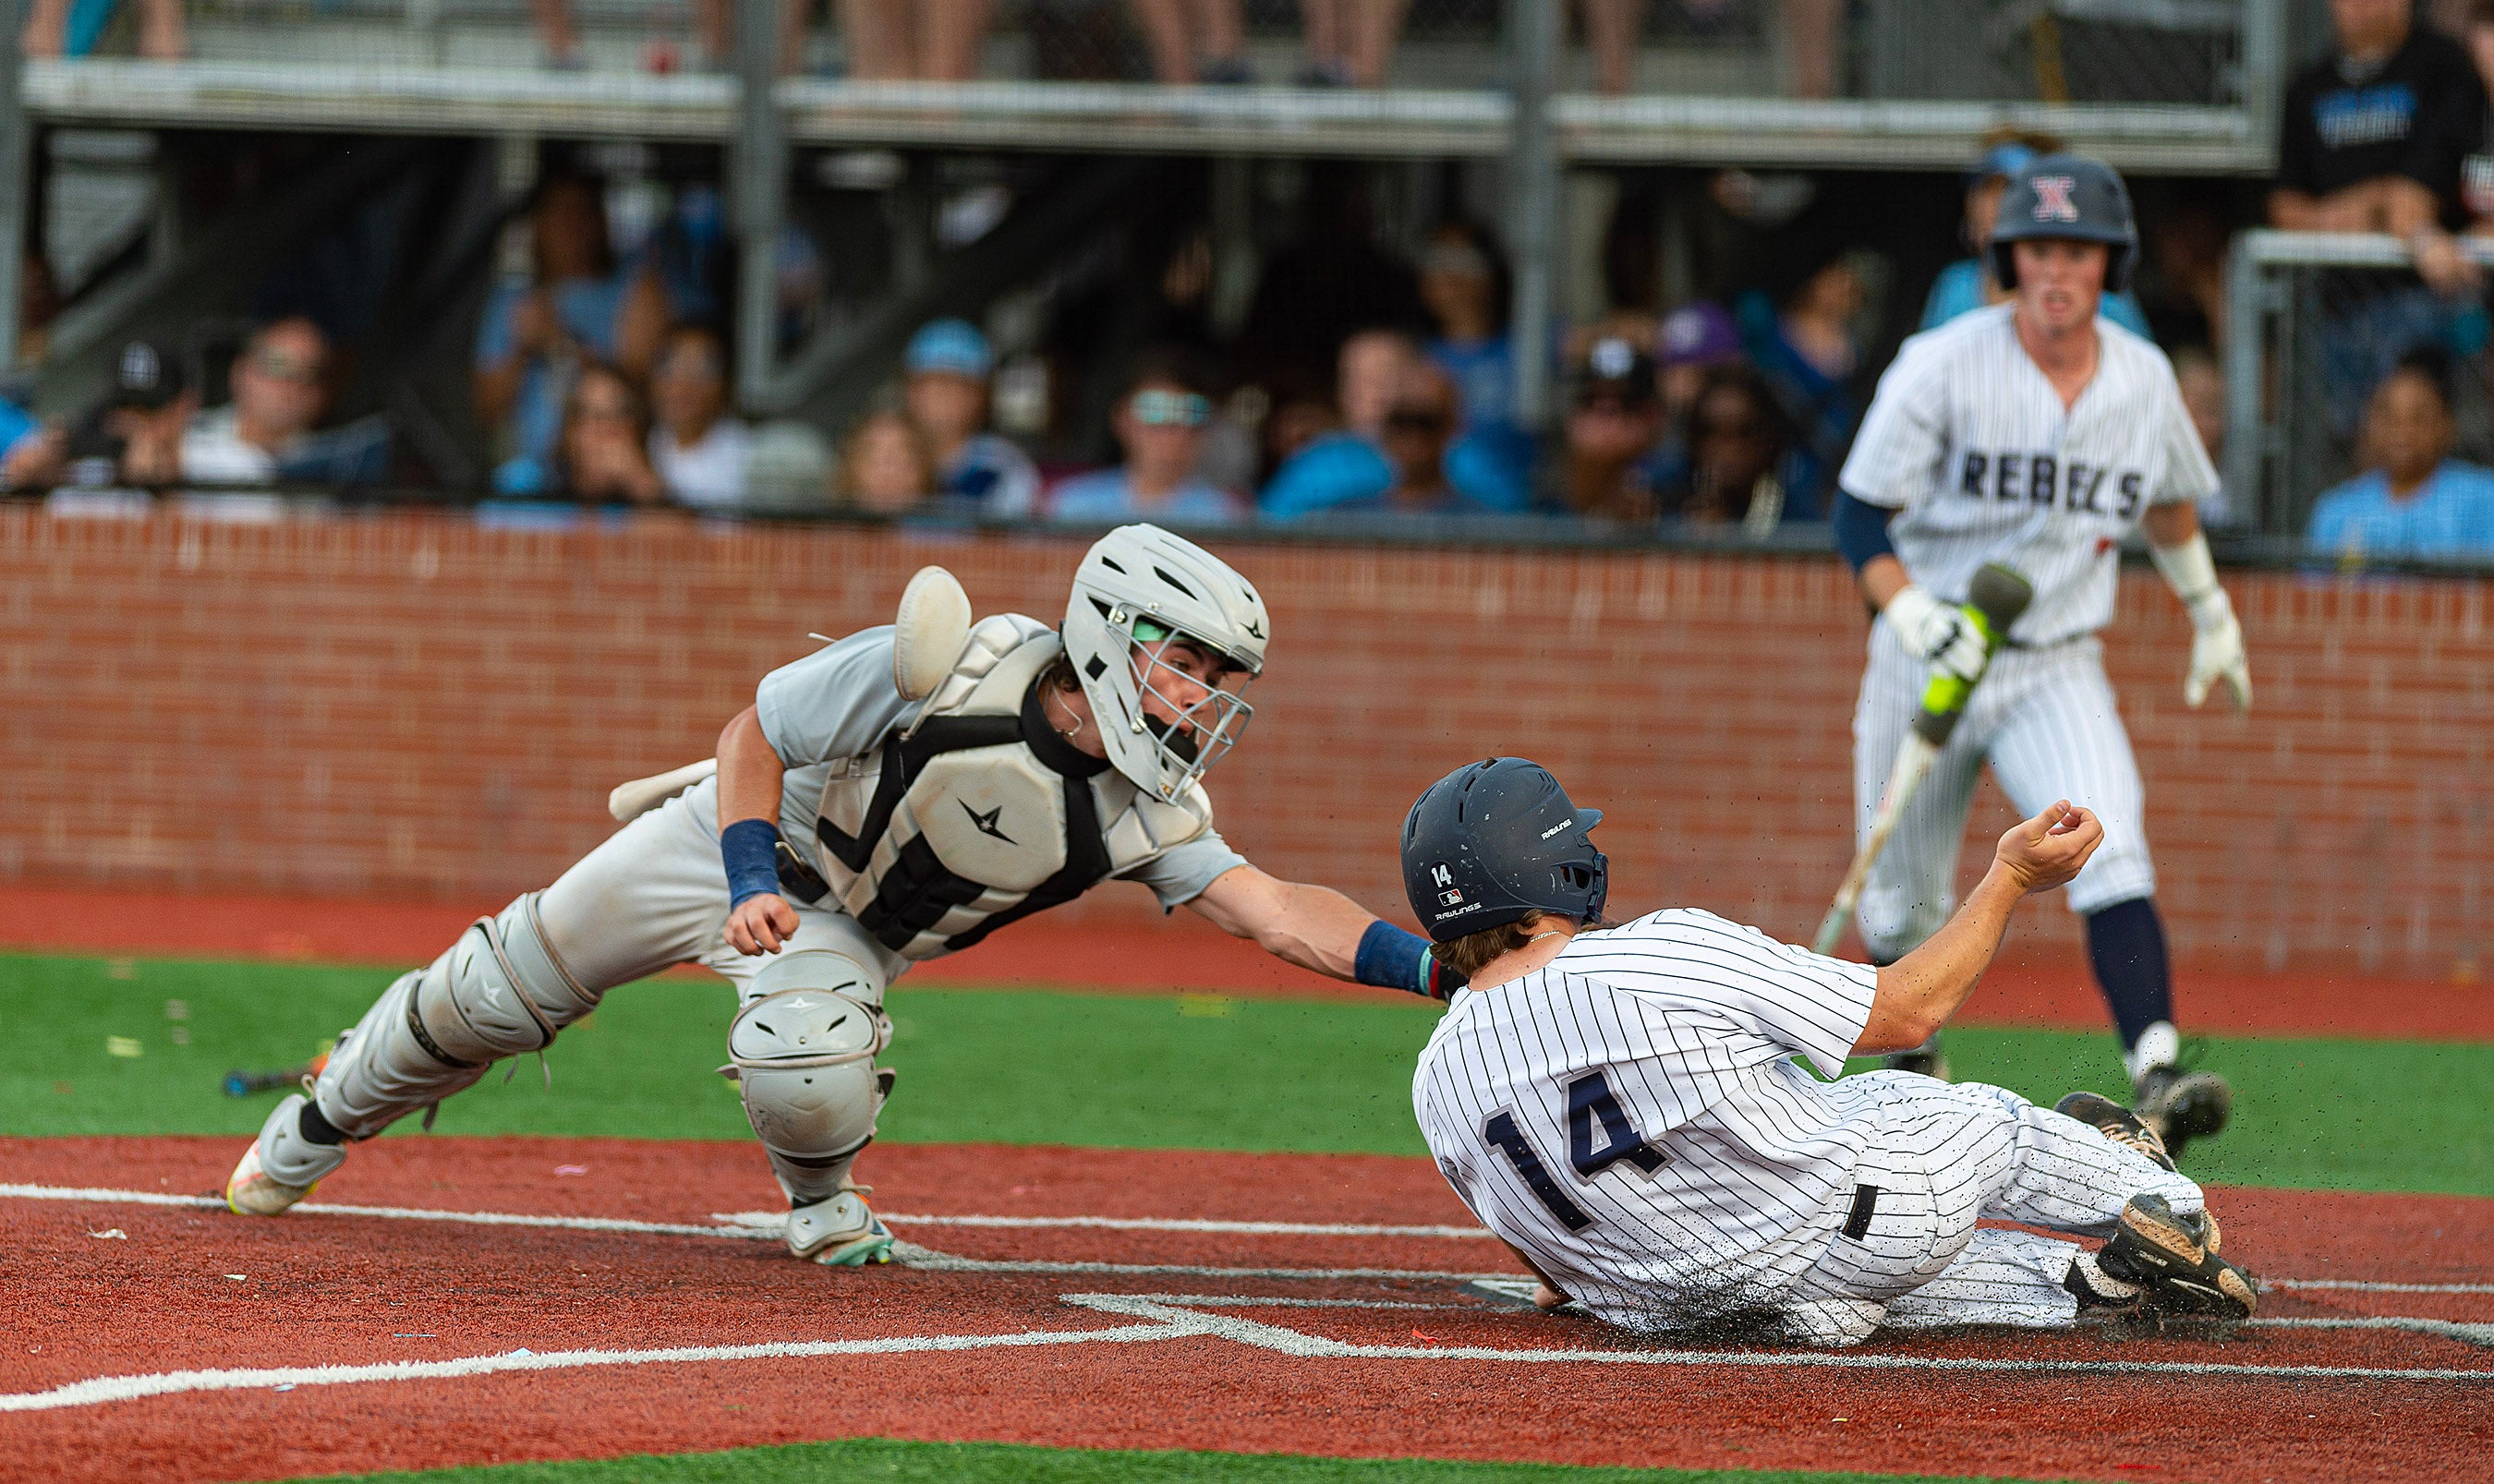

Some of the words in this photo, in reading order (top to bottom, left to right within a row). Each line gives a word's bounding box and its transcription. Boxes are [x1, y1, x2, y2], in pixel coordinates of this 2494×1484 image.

[1965, 452, 2142, 519] REBELS
[1431, 864, 1452, 887] 14
[1435, 902, 1482, 921] RAWLINGS
[1478, 1065, 1677, 1237] 14
